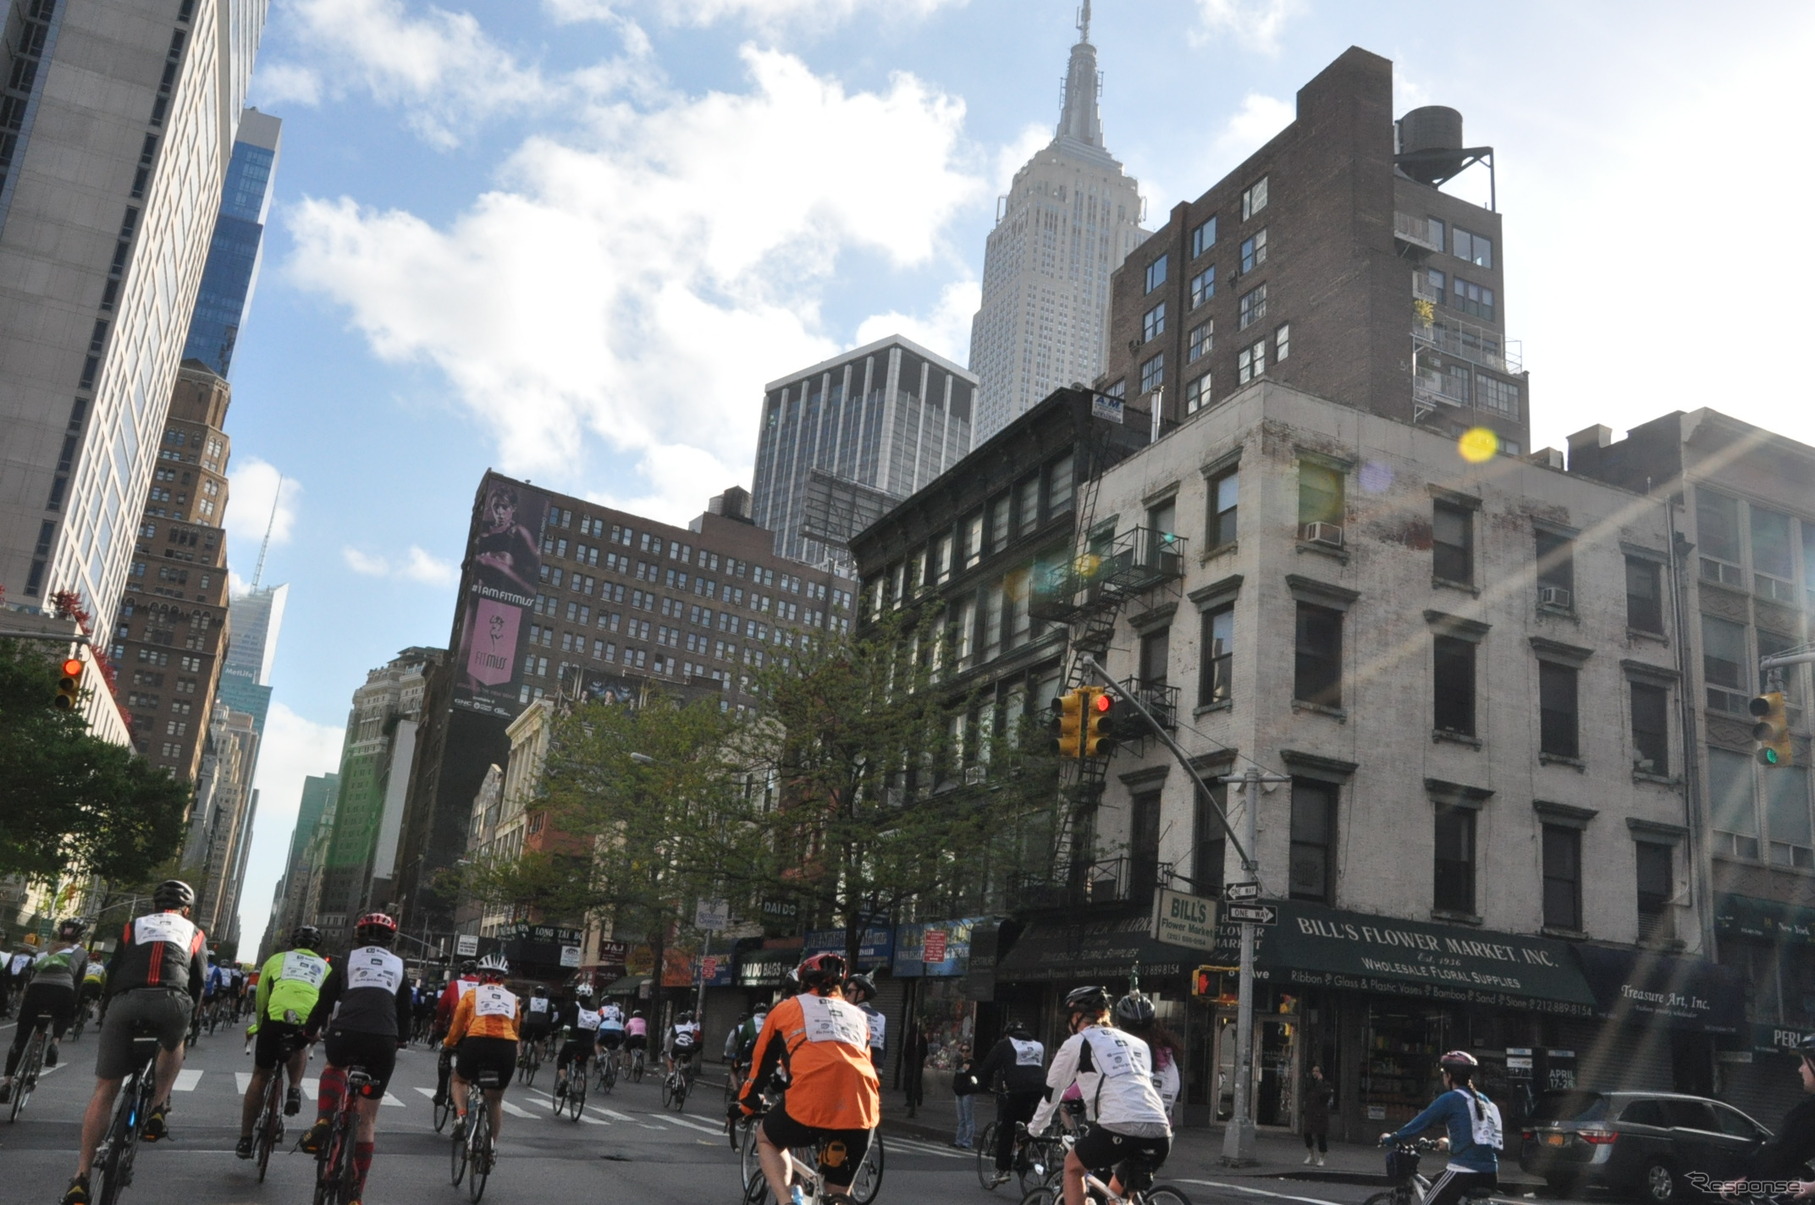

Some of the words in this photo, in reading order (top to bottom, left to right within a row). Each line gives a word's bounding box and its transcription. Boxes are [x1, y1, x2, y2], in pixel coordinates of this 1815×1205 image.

[474, 650, 507, 670] FITMISS
[225, 667, 253, 678] MetLife
[782, 903, 797, 916] DO
[1171, 897, 1207, 924] BILL'S
[1234, 909, 1248, 918] ONE
[1255, 910, 1270, 919] WAY
[535, 927, 554, 938] LONG
[1161, 917, 1186, 931] Flower
[1188, 923, 1214, 937] Market
[1296, 916, 1359, 942] BILL'S
[1362, 926, 1442, 952] FLOWER
[1521, 947, 1560, 969] INC.
[763, 961, 782, 977] BAGS
[1361, 957, 1428, 978] WHOLESALE
[1429, 964, 1472, 983] FLORAL
[1472, 971, 1521, 989] SUPPLIES
[1291, 970, 1322, 984] Ribbon
[1334, 975, 1359, 989] Glass
[1360, 978, 1368, 989] &
[1370, 979, 1396, 993] Plastic
[1433, 986, 1467, 1001] Bamboo
[1475, 991, 1497, 1004] Sand
[1620, 984, 1665, 1004] Treasure
[1666, 992, 1689, 1009] Art,
[1691, 996, 1711, 1011] Inc.
[1549, 1069, 1575, 1079] APRIL
